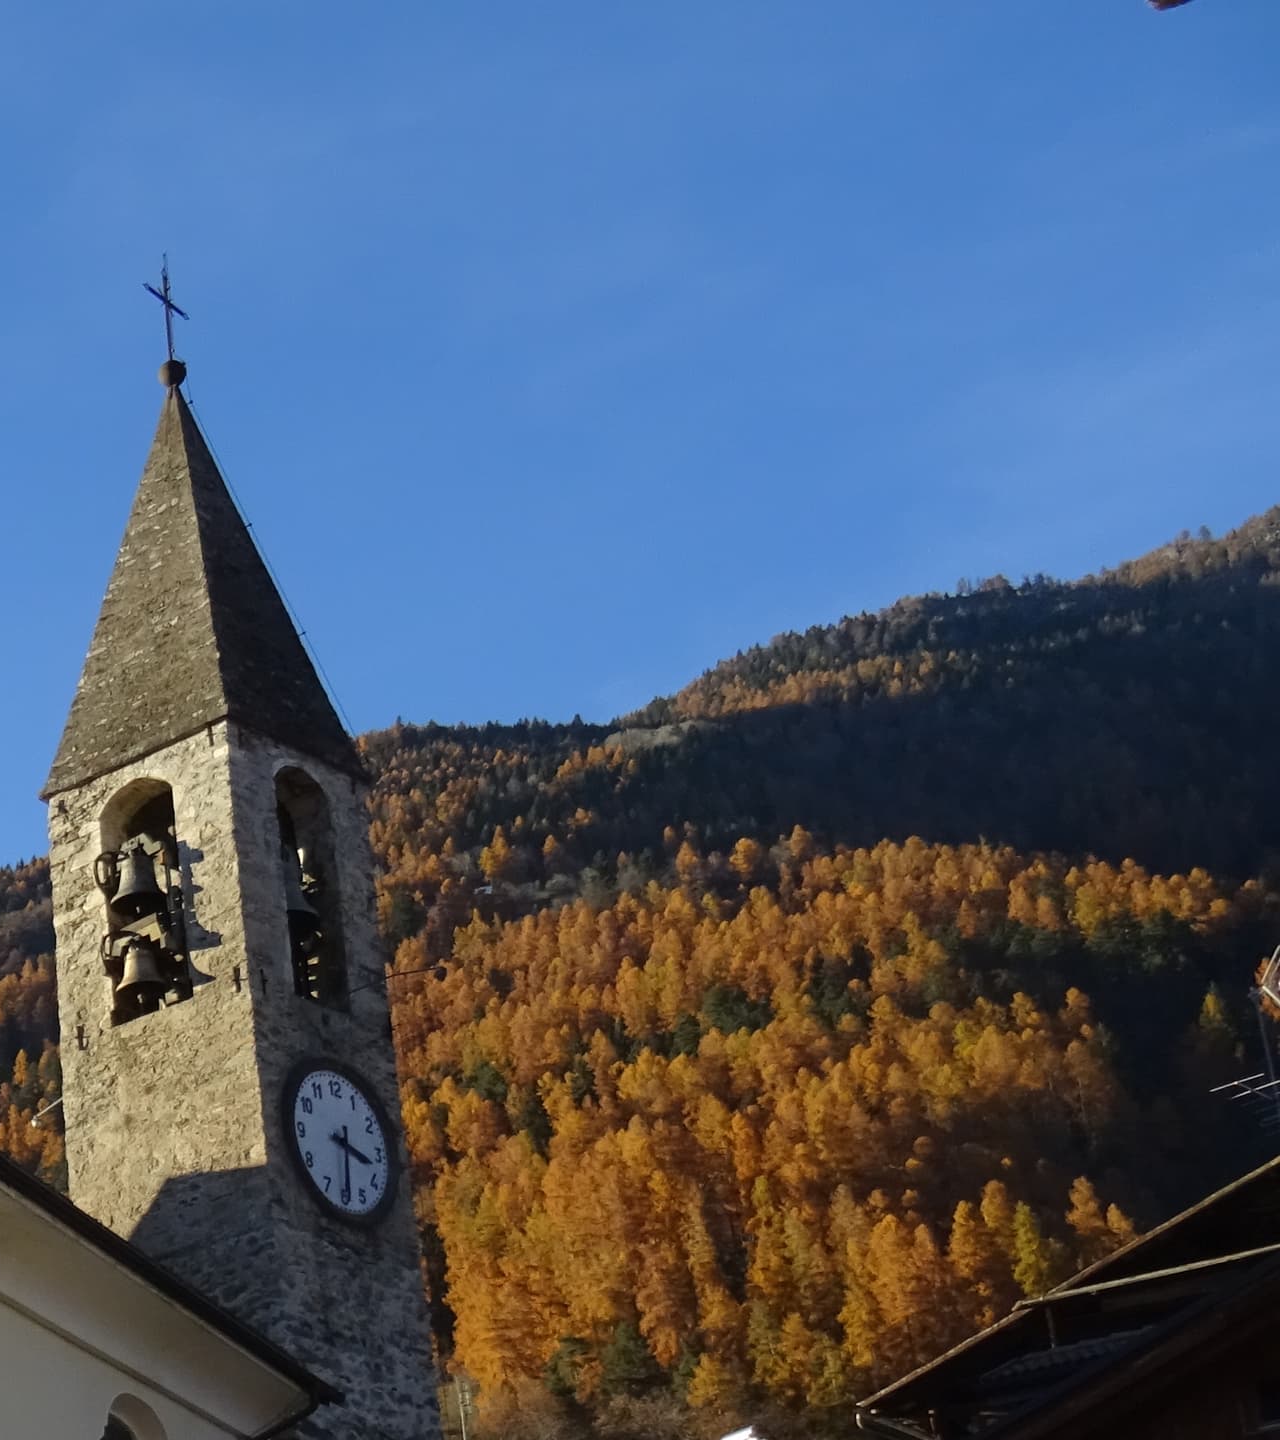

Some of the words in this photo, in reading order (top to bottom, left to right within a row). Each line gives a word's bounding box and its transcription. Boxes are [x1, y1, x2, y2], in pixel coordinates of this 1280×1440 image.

[311, 1082, 322, 1100] 11
[328, 1080, 342, 1099] 12
[301, 1097, 313, 1114] 10
[350, 1094, 356, 1111] 1
[297, 1121, 306, 1138] 9
[365, 1117, 373, 1135] 2
[305, 1151, 313, 1168] 8
[374, 1147, 382, 1163] 3
[323, 1176, 332, 1193] 7
[370, 1173, 378, 1190] 4
[358, 1189, 366, 1205] 5
